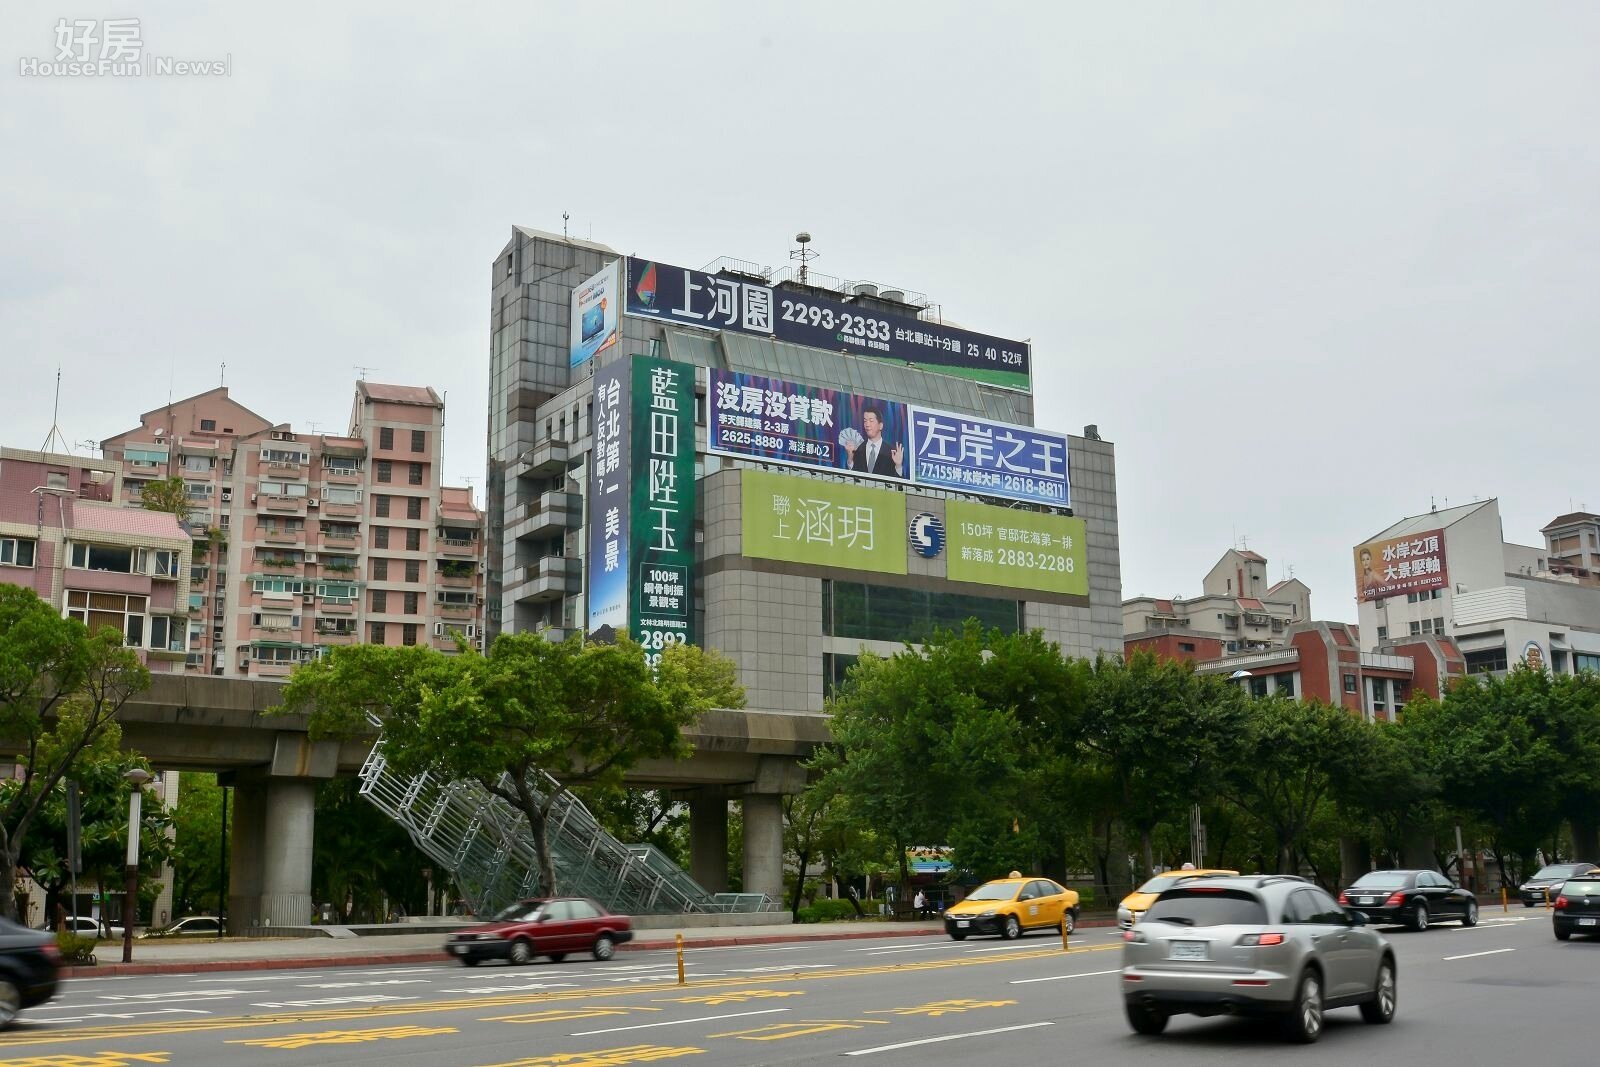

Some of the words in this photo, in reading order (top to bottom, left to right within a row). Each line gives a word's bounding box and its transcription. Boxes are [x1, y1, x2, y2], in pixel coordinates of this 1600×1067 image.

[671, 270, 774, 334] 上河園
[780, 300, 891, 342] 2293-2333
[895, 326, 962, 355] 台北車站十分鐘
[967, 343, 980, 358] 25
[984, 347, 998, 361] 40
[1002, 350, 1023, 367] 52坪
[764, 420, 789, 434] 2-3房
[722, 429, 783, 450] 2625-8880
[788, 439, 830, 458] 海洋都心2
[916, 417, 1065, 480] 左岸之王
[649, 367, 679, 553] 藍田陞玉
[1004, 476, 1064, 499] 2618-8811
[772, 494, 792, 541] 聯上
[796, 497, 875, 553] 涵玥
[960, 522, 993, 540] 150坪
[998, 526, 1073, 550] 官邸花海第一排
[961, 546, 994, 565] 新落成
[997, 547, 1075, 574] 2883-2288
[1382, 535, 1440, 562] 水岸之頂
[649, 569, 679, 584] 100坪
[1384, 556, 1441, 582] 大景壓軸
[643, 582, 684, 597] 鋼骨制振
[649, 595, 679, 610] 景觀宅
